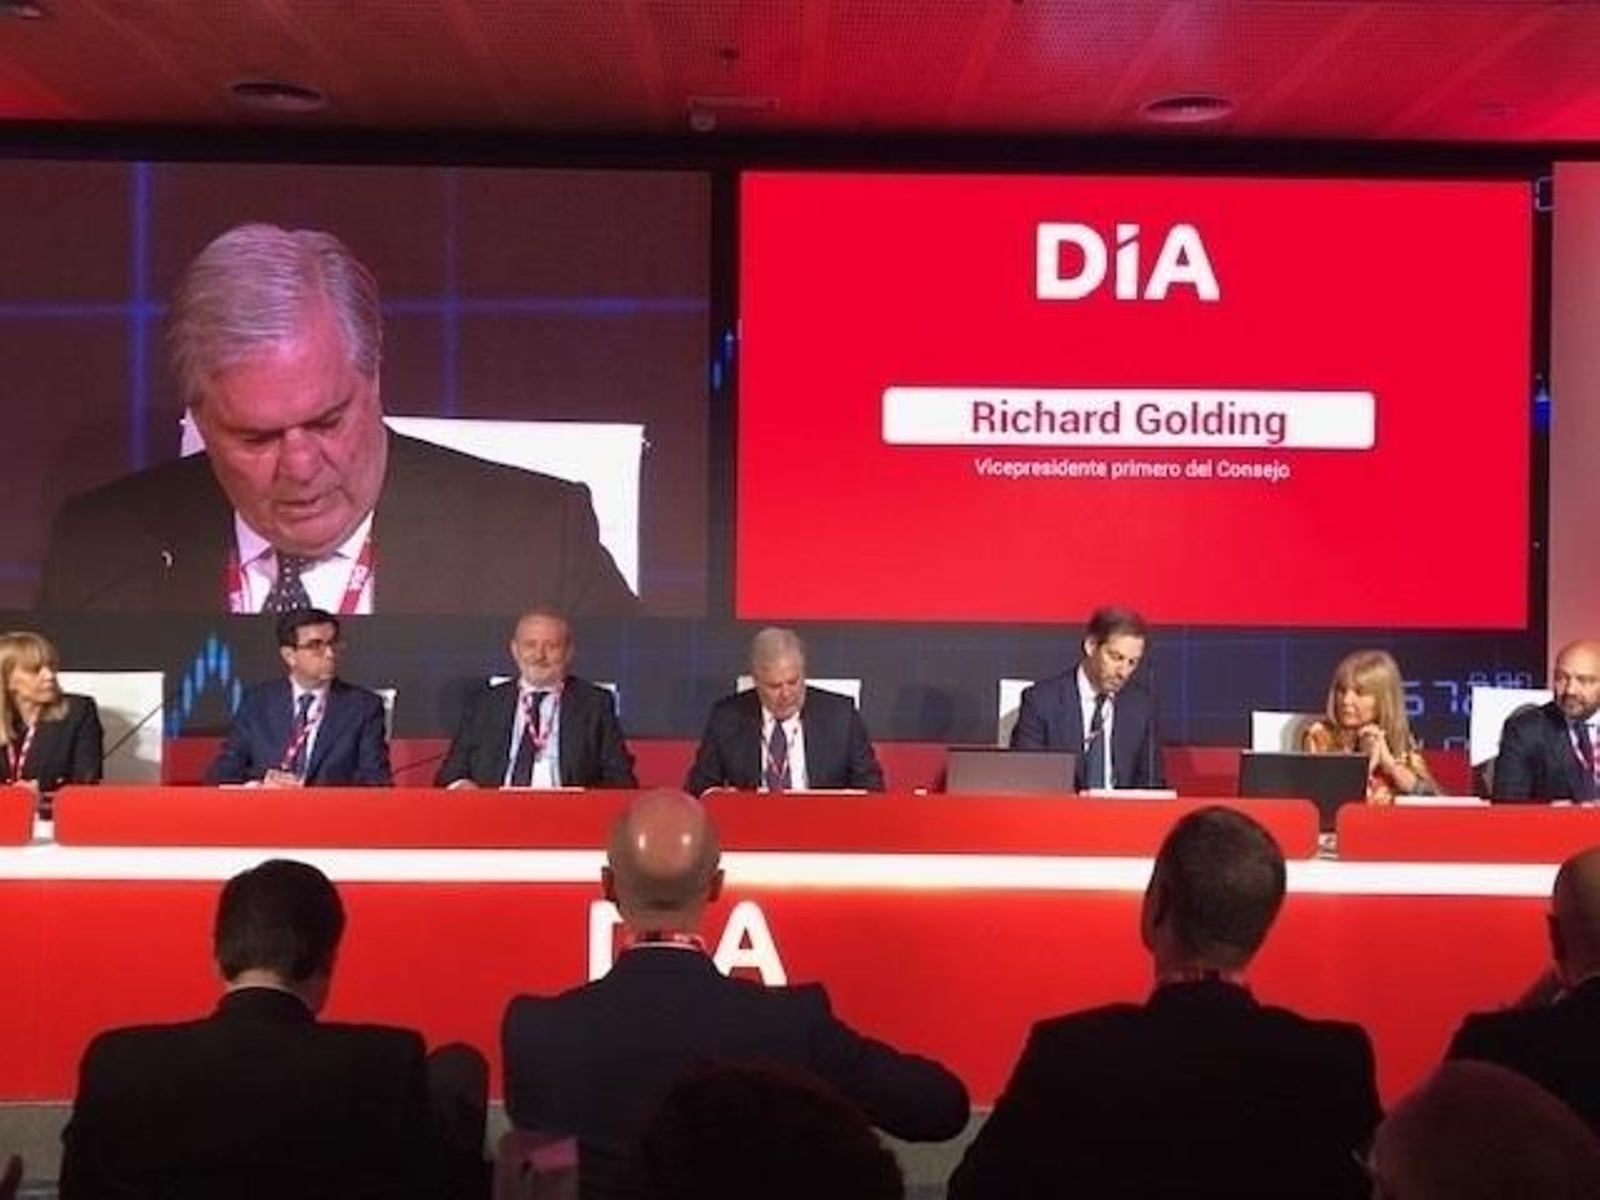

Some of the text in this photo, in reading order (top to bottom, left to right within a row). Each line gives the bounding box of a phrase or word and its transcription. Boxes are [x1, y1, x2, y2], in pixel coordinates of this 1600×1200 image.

[971, 400, 1288, 445] Richard Golding
[975, 458, 1290, 482] Vicepresidente primero del Consejo
